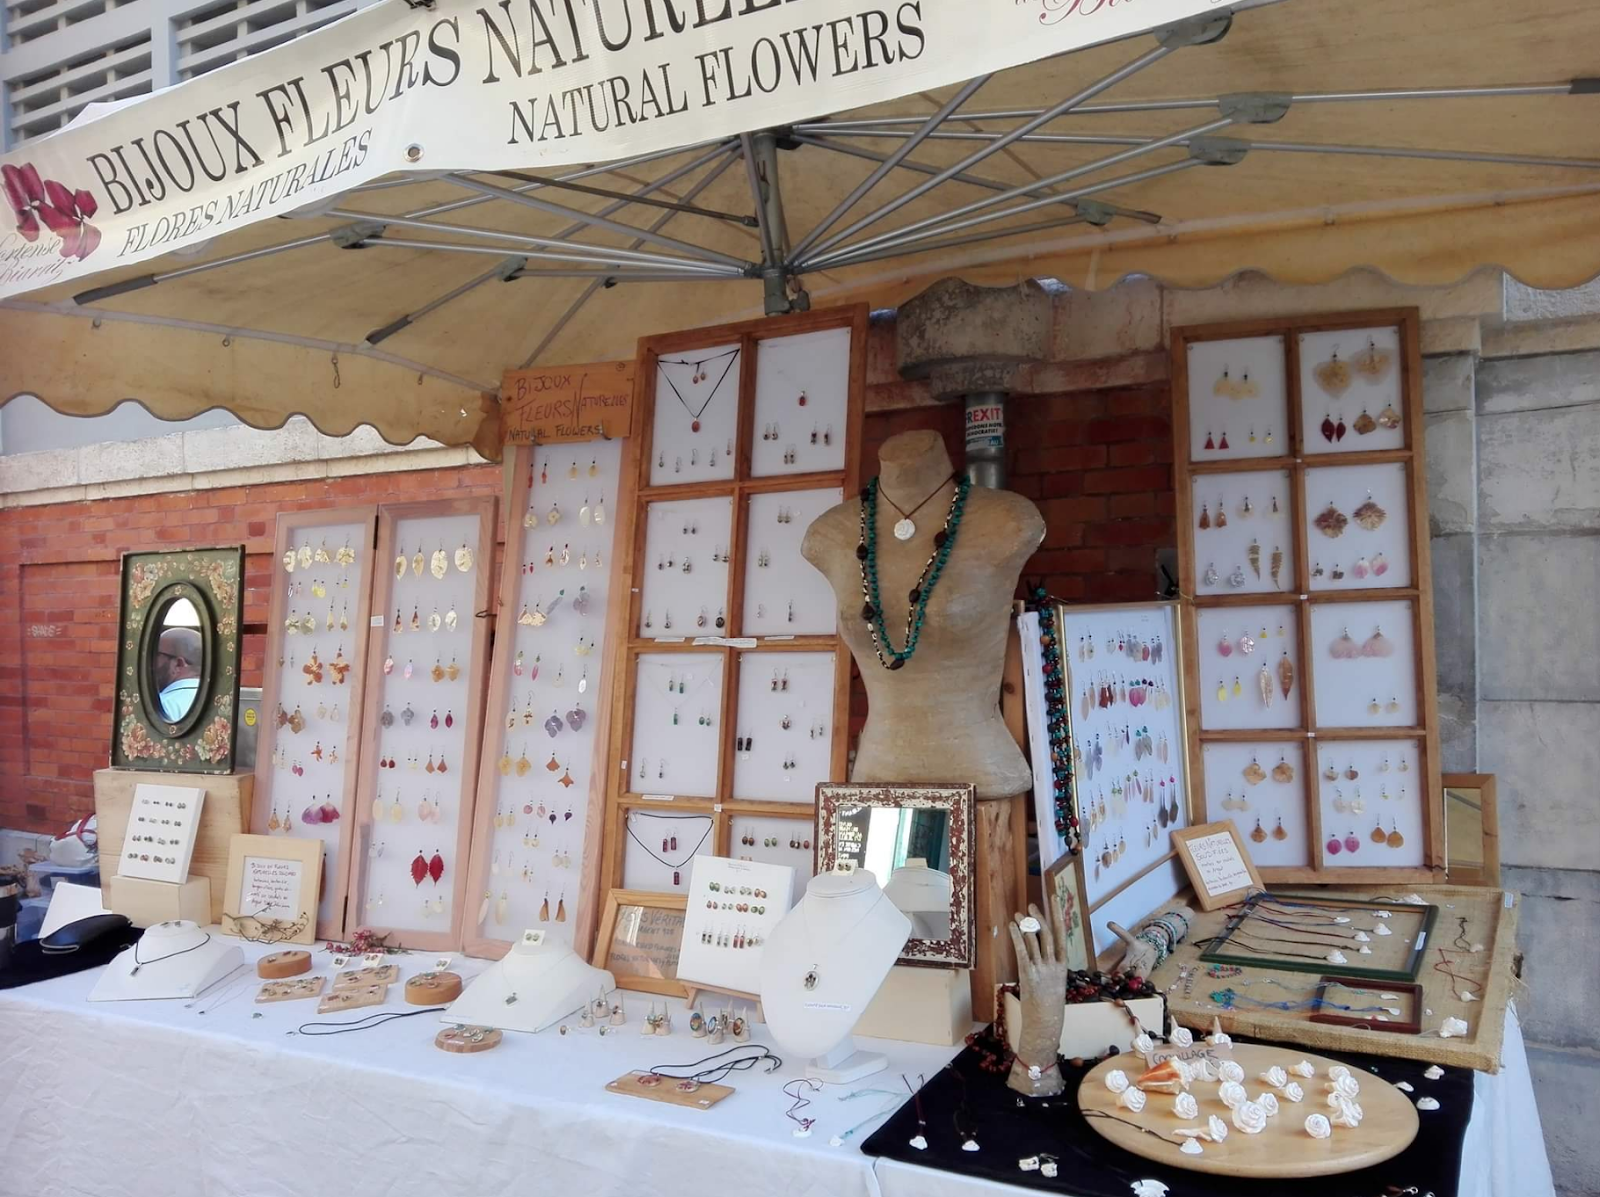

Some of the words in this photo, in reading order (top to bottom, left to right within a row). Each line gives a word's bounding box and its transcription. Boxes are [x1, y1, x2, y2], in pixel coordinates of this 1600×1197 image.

[507, 62, 689, 144] NATURAL
[694, 0, 925, 109] FLOWERS
[86, 100, 265, 217] BIJOUX
[256, 16, 462, 158] FLEURS
[117, 199, 218, 258] FLORES
[218, 128, 373, 227] NATURALES
[514, 398, 573, 430] FLEURS
[555, 423, 600, 438] FLOWERS
[1152, 1048, 1219, 1065] COILLAGE
